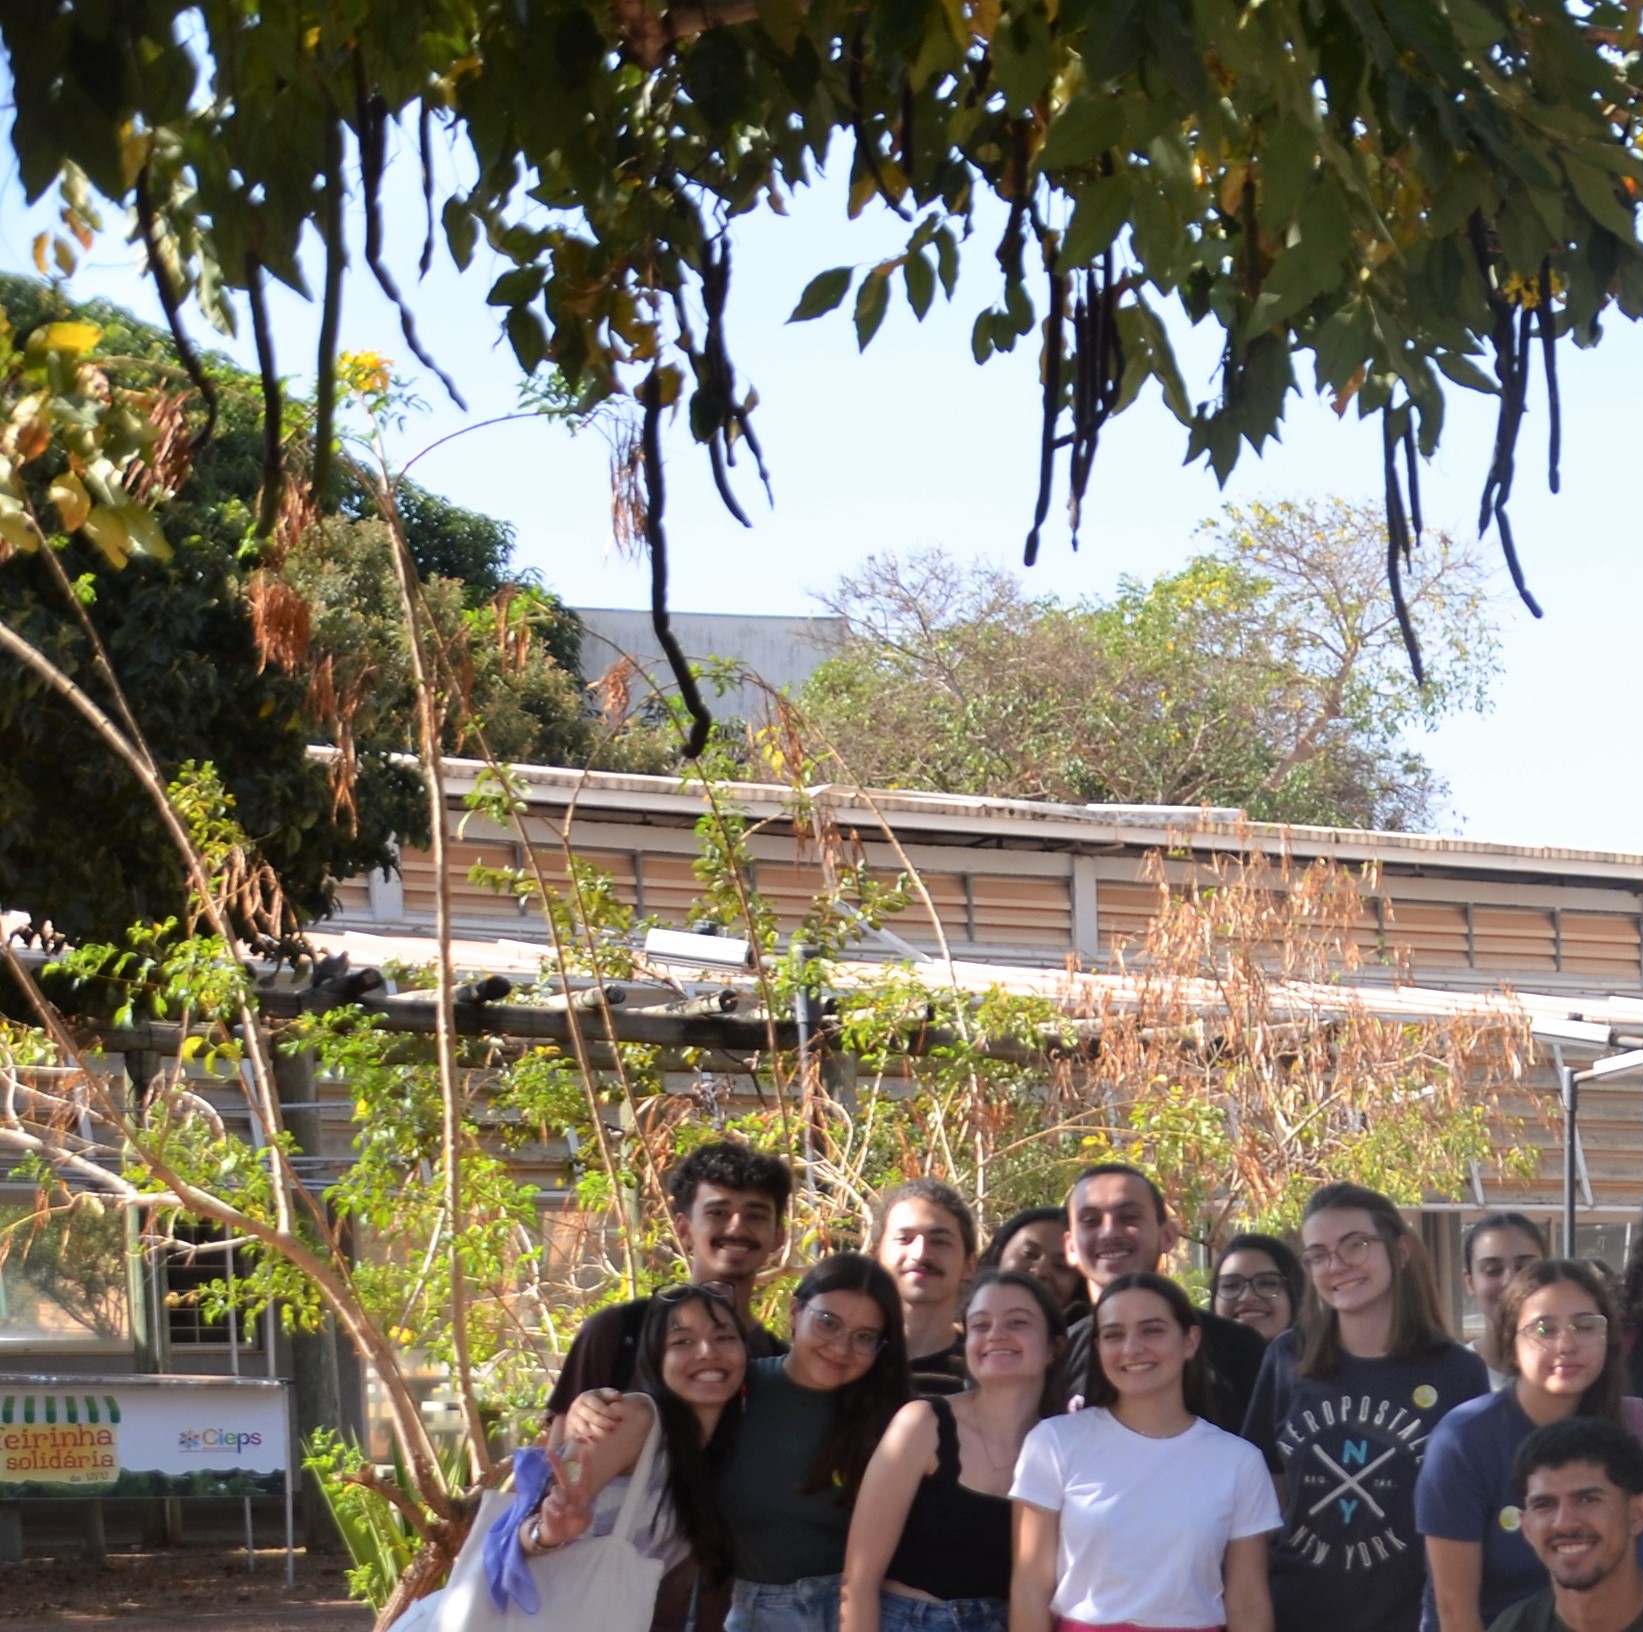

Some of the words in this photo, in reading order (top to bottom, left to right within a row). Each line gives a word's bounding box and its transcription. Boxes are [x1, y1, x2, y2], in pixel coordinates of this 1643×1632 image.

[202, 1428, 262, 1454] Cieps
[1342, 1439, 1368, 1464] N
[6, 1448, 115, 1470] solidária
[1339, 1499, 1358, 1524] Y
[1289, 1525, 1330, 1565] NEW
[1346, 1527, 1407, 1570] YORK
